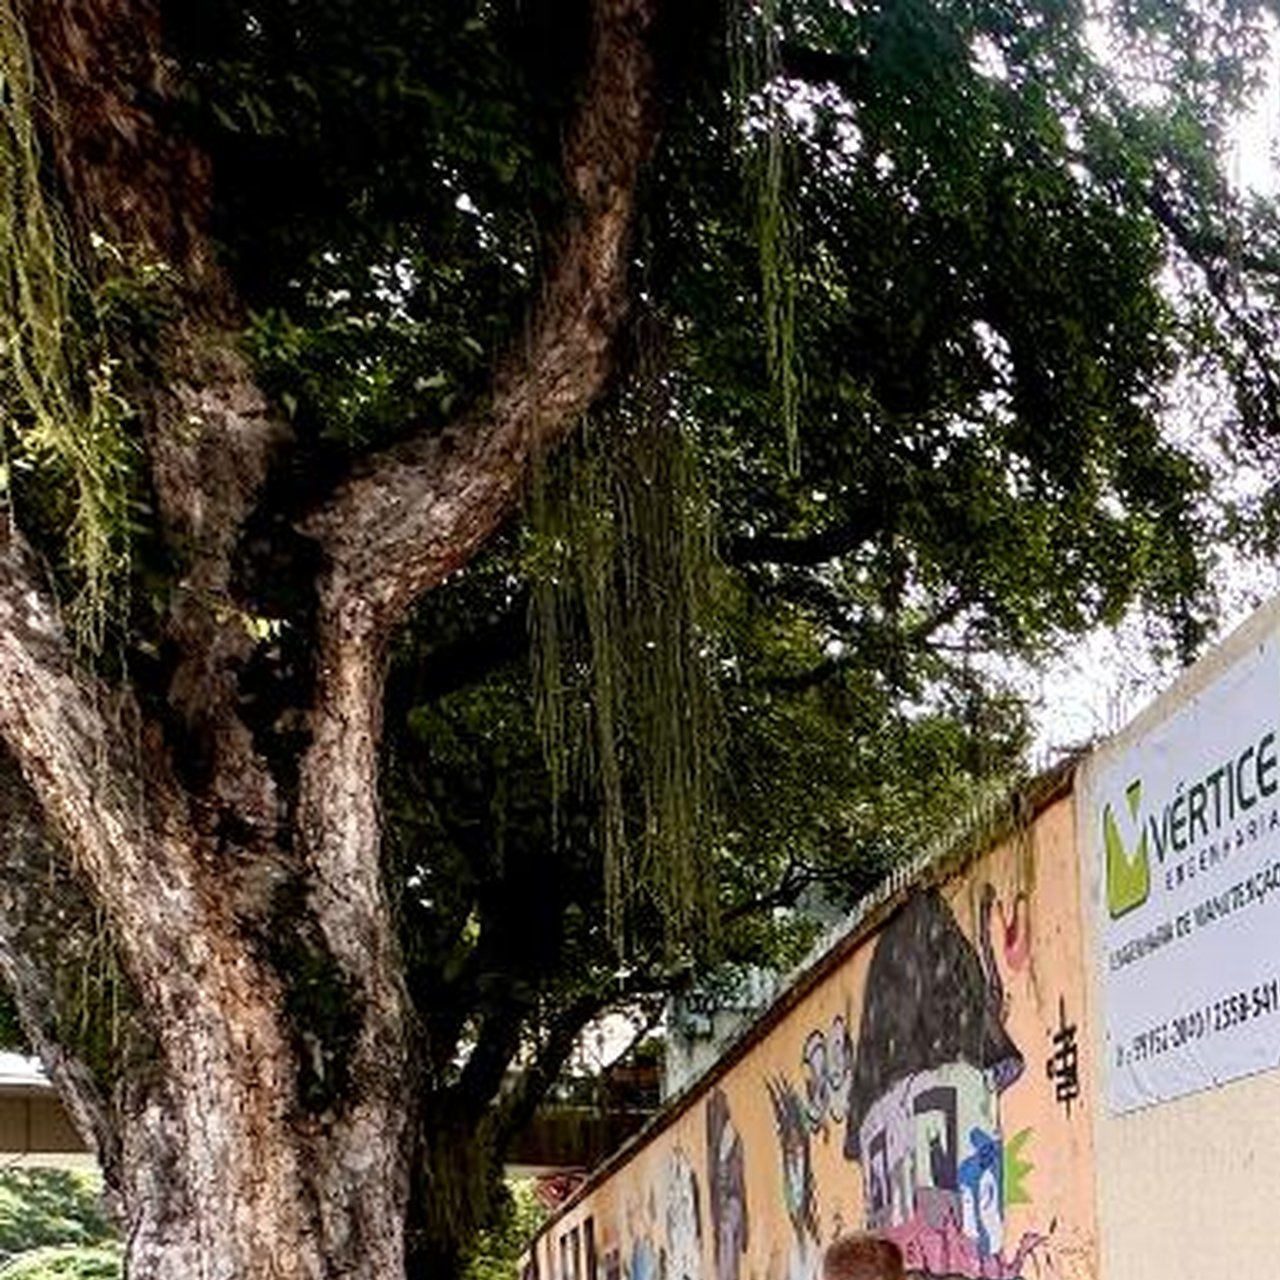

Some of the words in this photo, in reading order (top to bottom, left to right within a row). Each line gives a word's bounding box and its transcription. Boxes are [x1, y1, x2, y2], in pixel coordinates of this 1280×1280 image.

[1149, 732, 1279, 864] VÉRTICE
[1165, 809, 1280, 891] ENGENHARIA
[1175, 910, 1192, 938] DE
